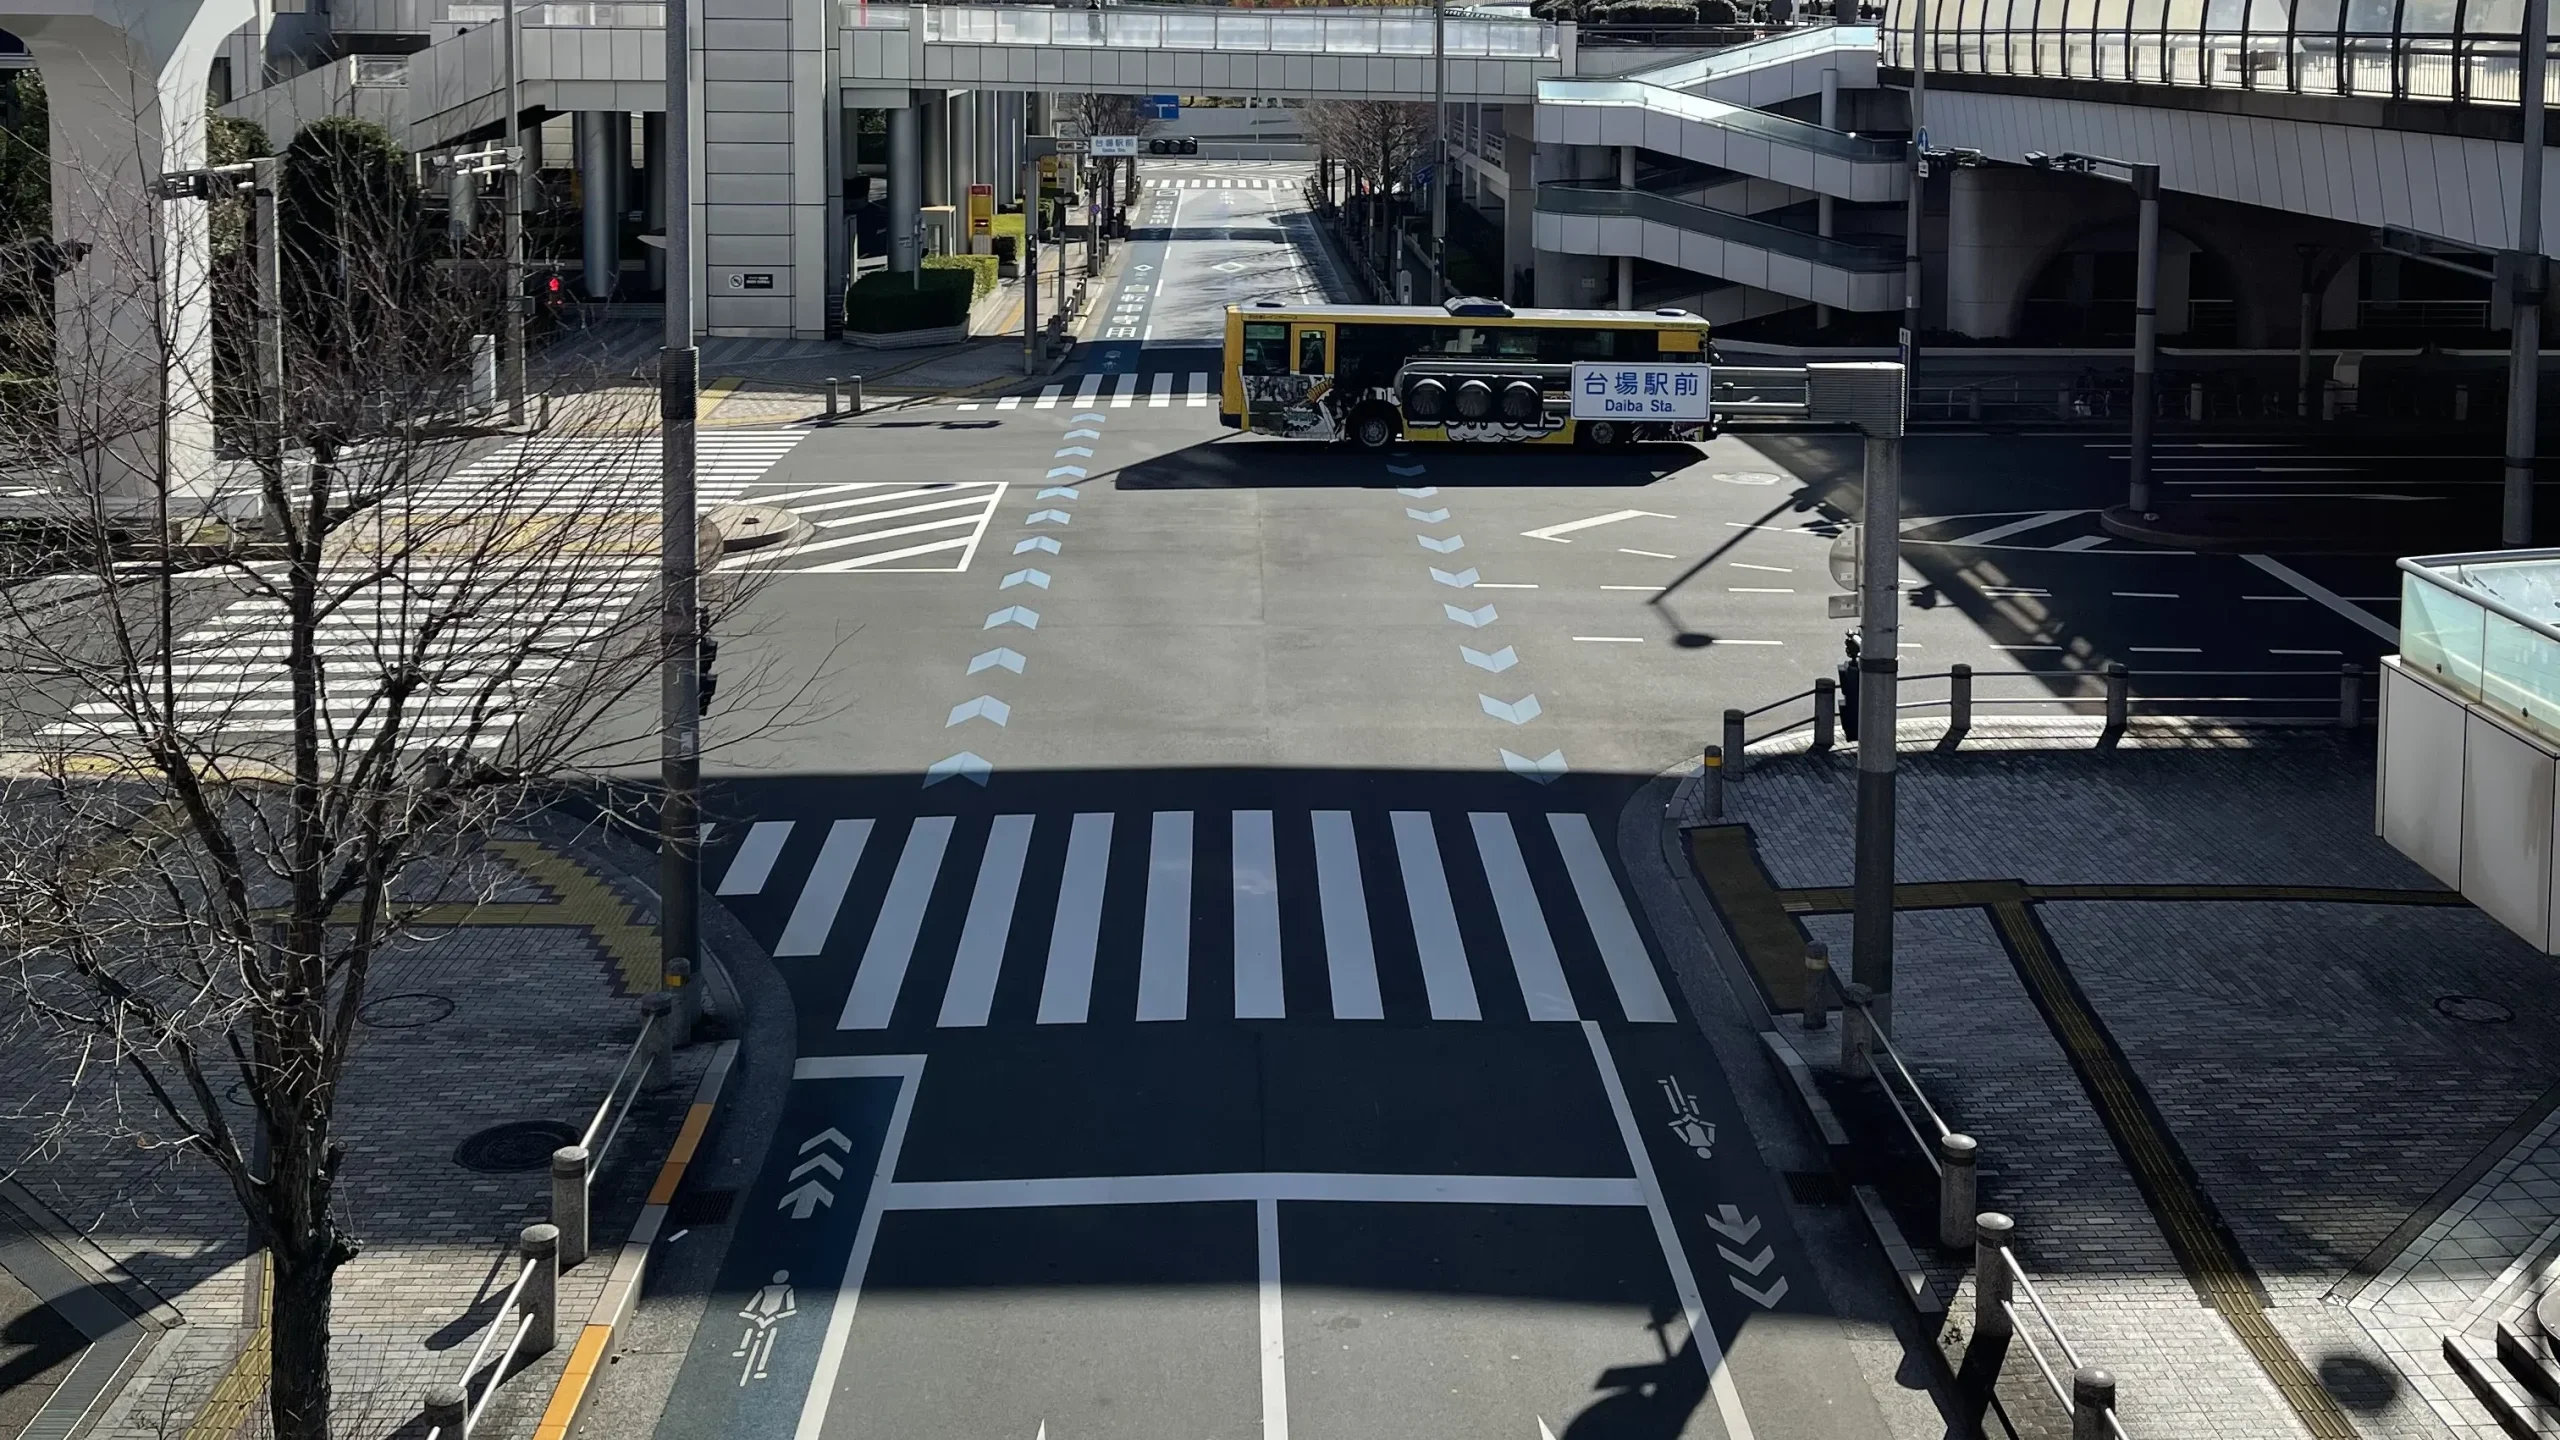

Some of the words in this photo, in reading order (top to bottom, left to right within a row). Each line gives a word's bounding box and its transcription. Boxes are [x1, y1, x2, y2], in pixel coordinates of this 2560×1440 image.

[1584, 372, 1698, 396] 台場駅前
[1605, 399, 1643, 412] Daiba
[1650, 400, 1676, 412] Sta.
